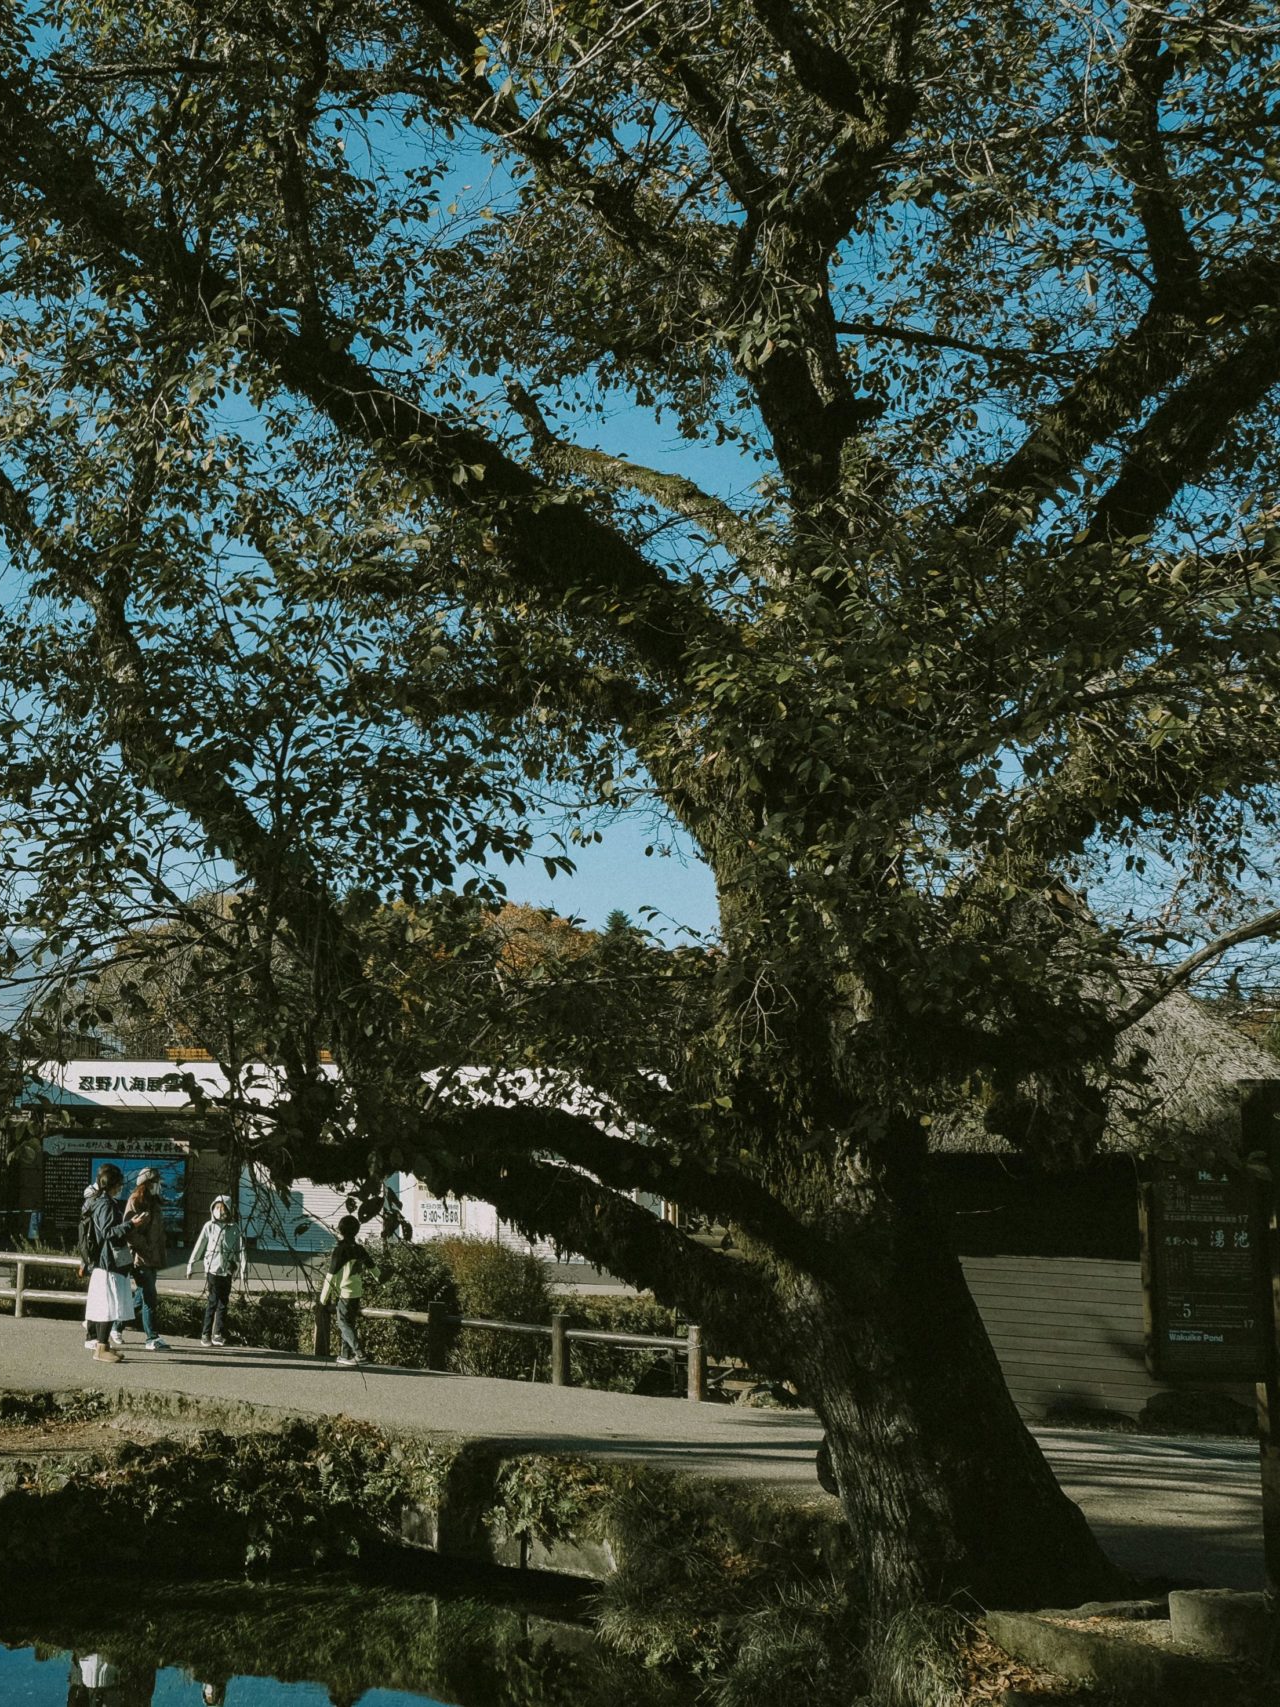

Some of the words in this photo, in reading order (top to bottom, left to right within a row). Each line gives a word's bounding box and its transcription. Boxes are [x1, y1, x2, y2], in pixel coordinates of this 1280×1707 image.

[1183, 1303, 1192, 1318] 5
[1168, 1333, 1202, 1342] Wakuike
[1203, 1334, 1224, 1343] Pond
